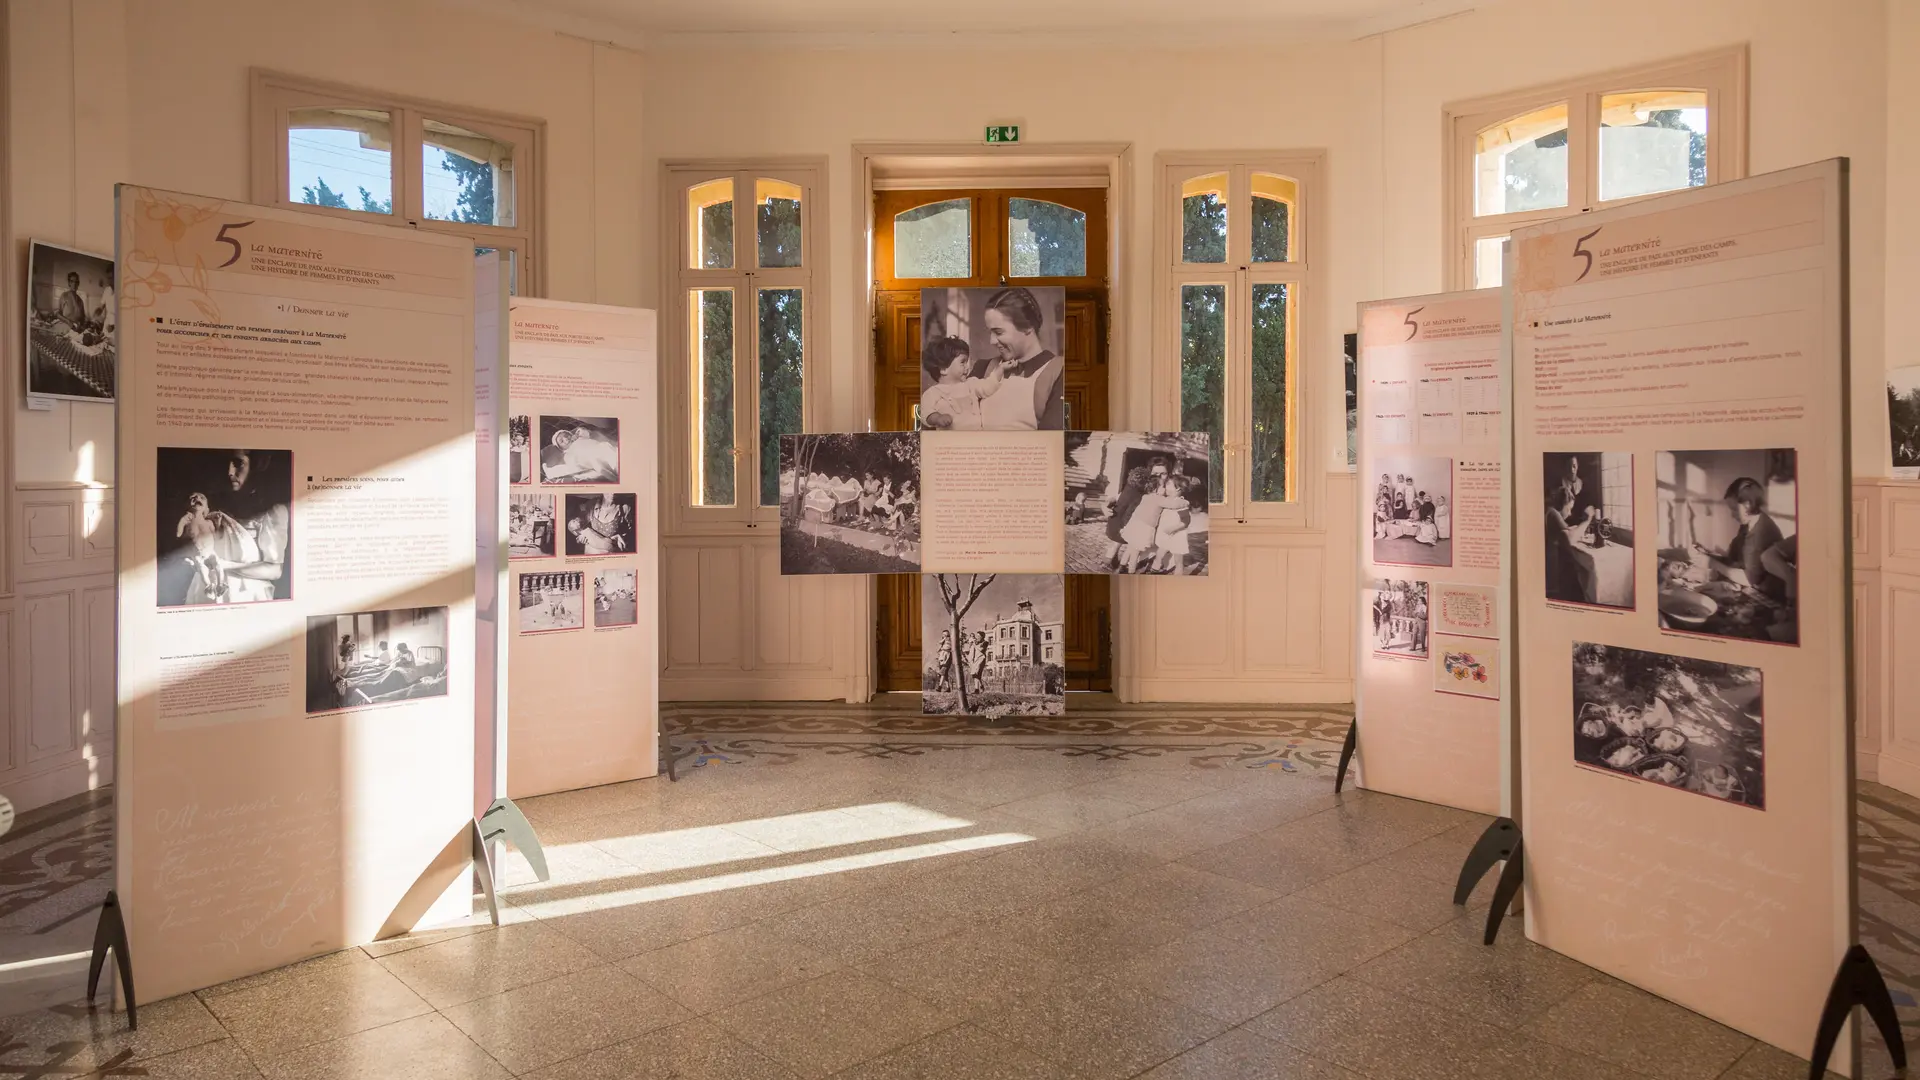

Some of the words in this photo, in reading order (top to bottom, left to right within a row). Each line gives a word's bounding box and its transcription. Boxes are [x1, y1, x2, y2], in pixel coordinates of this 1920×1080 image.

[215, 220, 255, 268] 5
[1572, 226, 1603, 283] 5
[251, 257, 265, 265] UNE
[268, 259, 297, 269] ENCLAVE
[309, 263, 322, 271] PAIX
[338, 266, 361, 276] PORTES
[362, 268, 374, 277] DES
[251, 264, 266, 272] UNE
[267, 266, 298, 276] HISTOIRE
[309, 270, 336, 280] FEMMES
[336, 273, 345, 281] ET
[346, 275, 380, 285] D'ENFANTS
[338, 310, 349, 318] vie
[1404, 306, 1425, 342] 5
